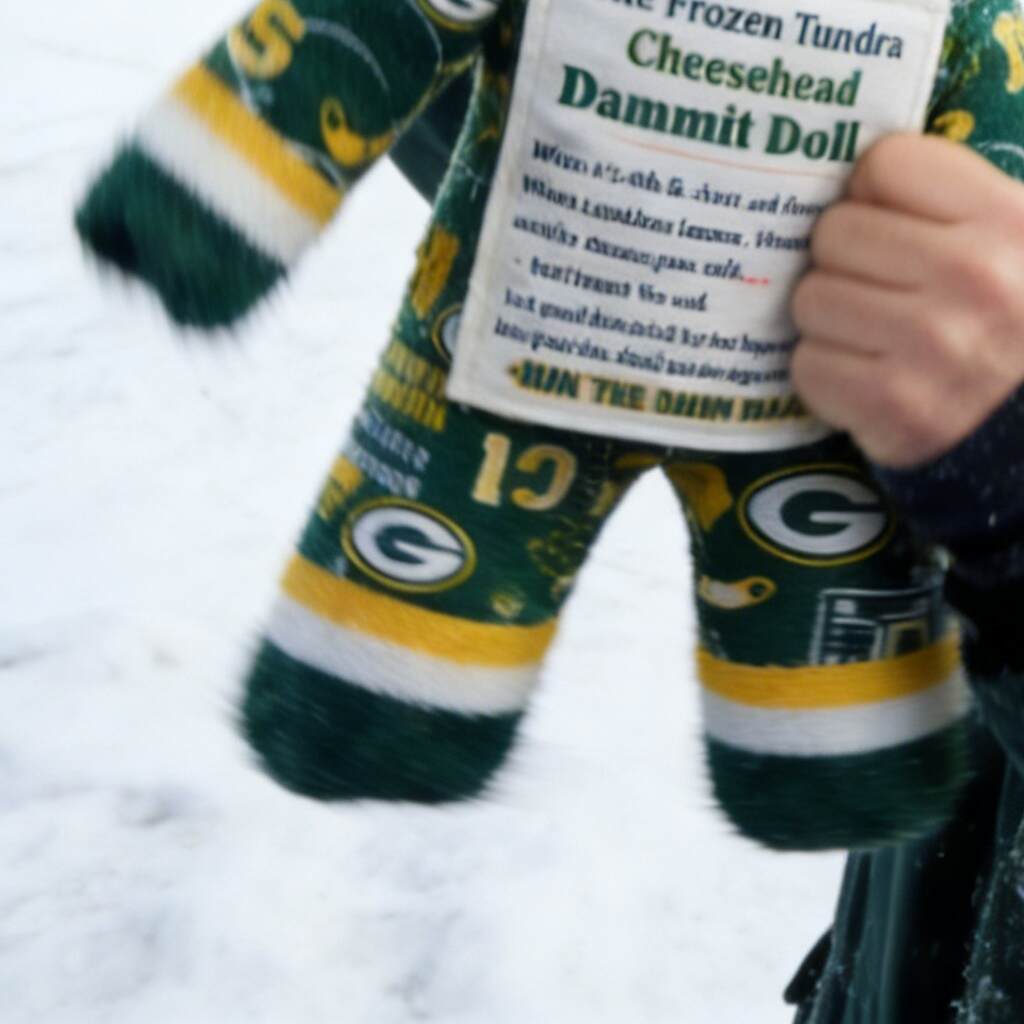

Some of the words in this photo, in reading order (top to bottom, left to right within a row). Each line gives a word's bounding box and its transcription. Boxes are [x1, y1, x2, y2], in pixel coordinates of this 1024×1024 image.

[626, 27, 863, 108] Cheesehead
[795, 11, 904, 60] Tundra
[557, 63, 755, 149] Dammit
[765, 113, 860, 163] Doll
